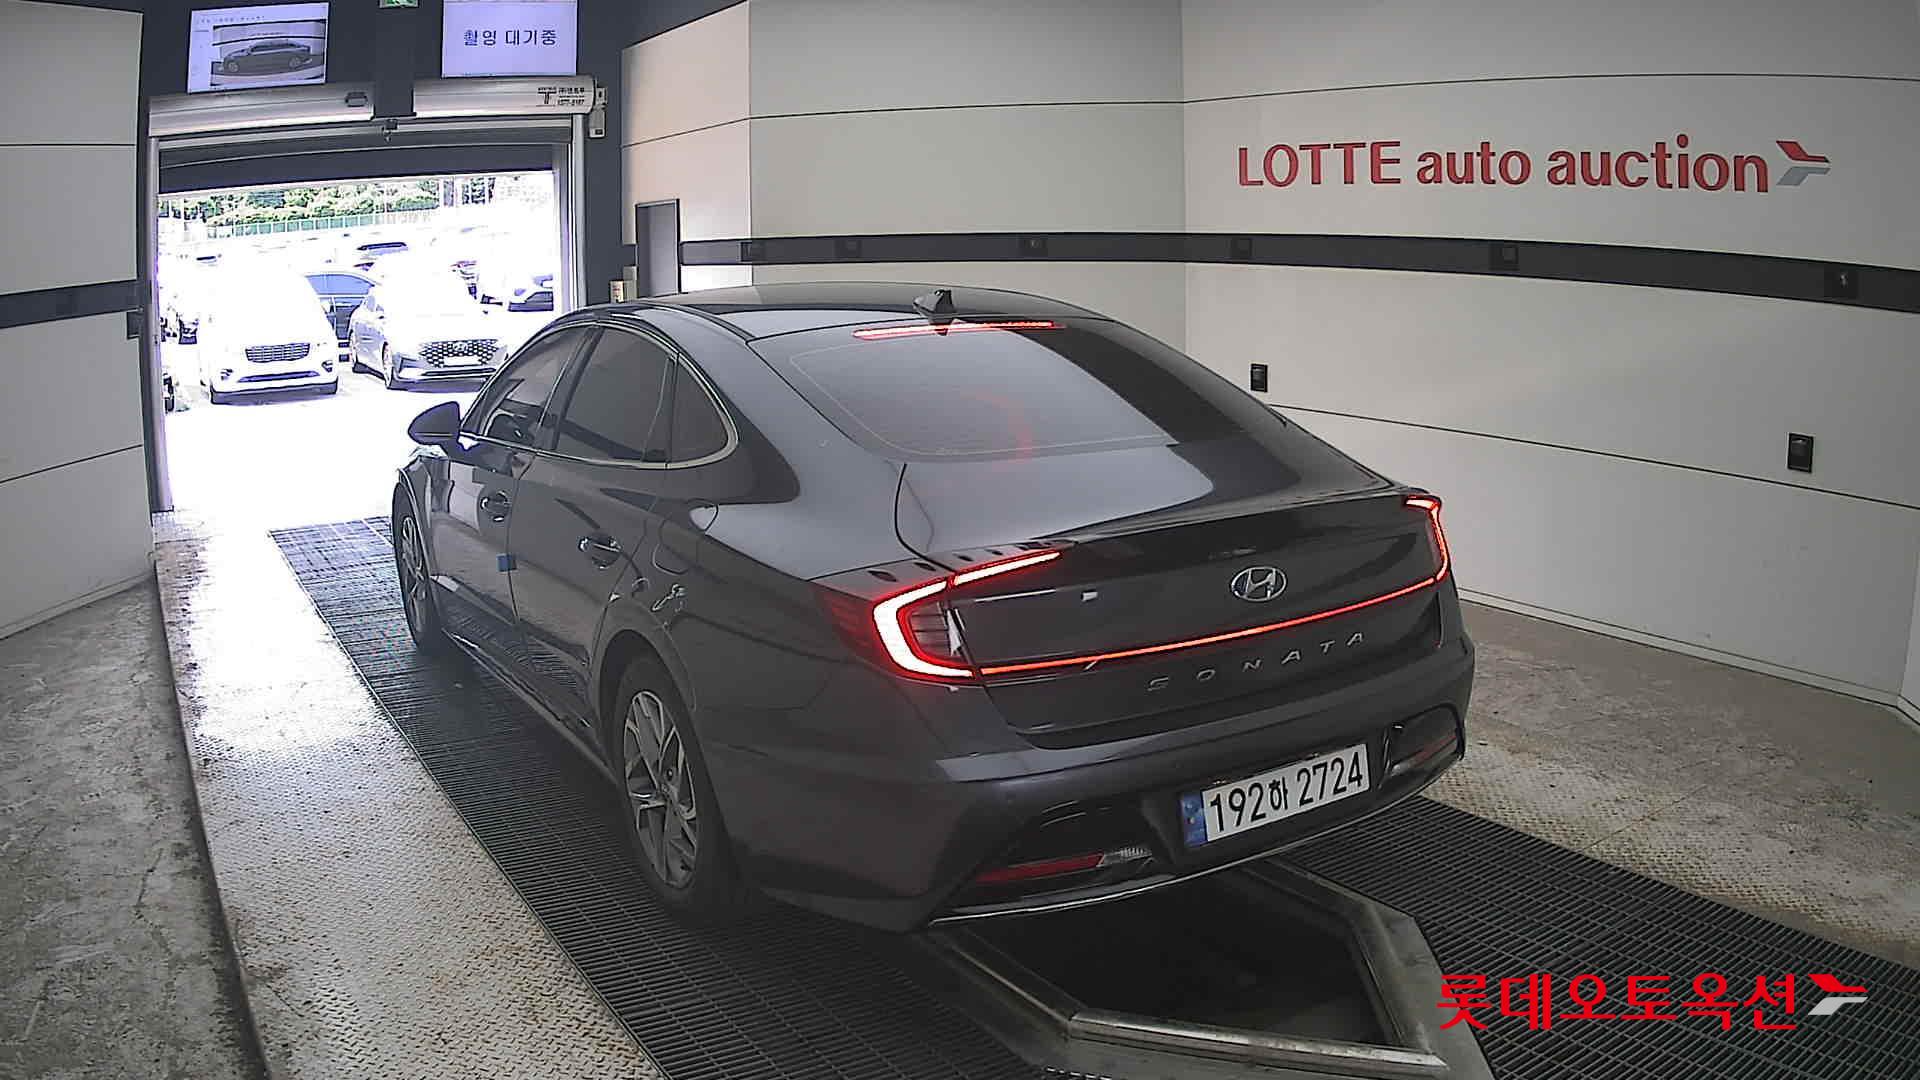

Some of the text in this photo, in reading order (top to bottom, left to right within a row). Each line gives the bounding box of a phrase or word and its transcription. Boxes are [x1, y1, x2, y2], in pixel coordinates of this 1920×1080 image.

[505, 29, 557, 46] 대기중
[1238, 133, 1769, 193] LOTTE auto auction
[1147, 632, 1364, 691] SONATA
[1210, 751, 1363, 832] 192하 2724
